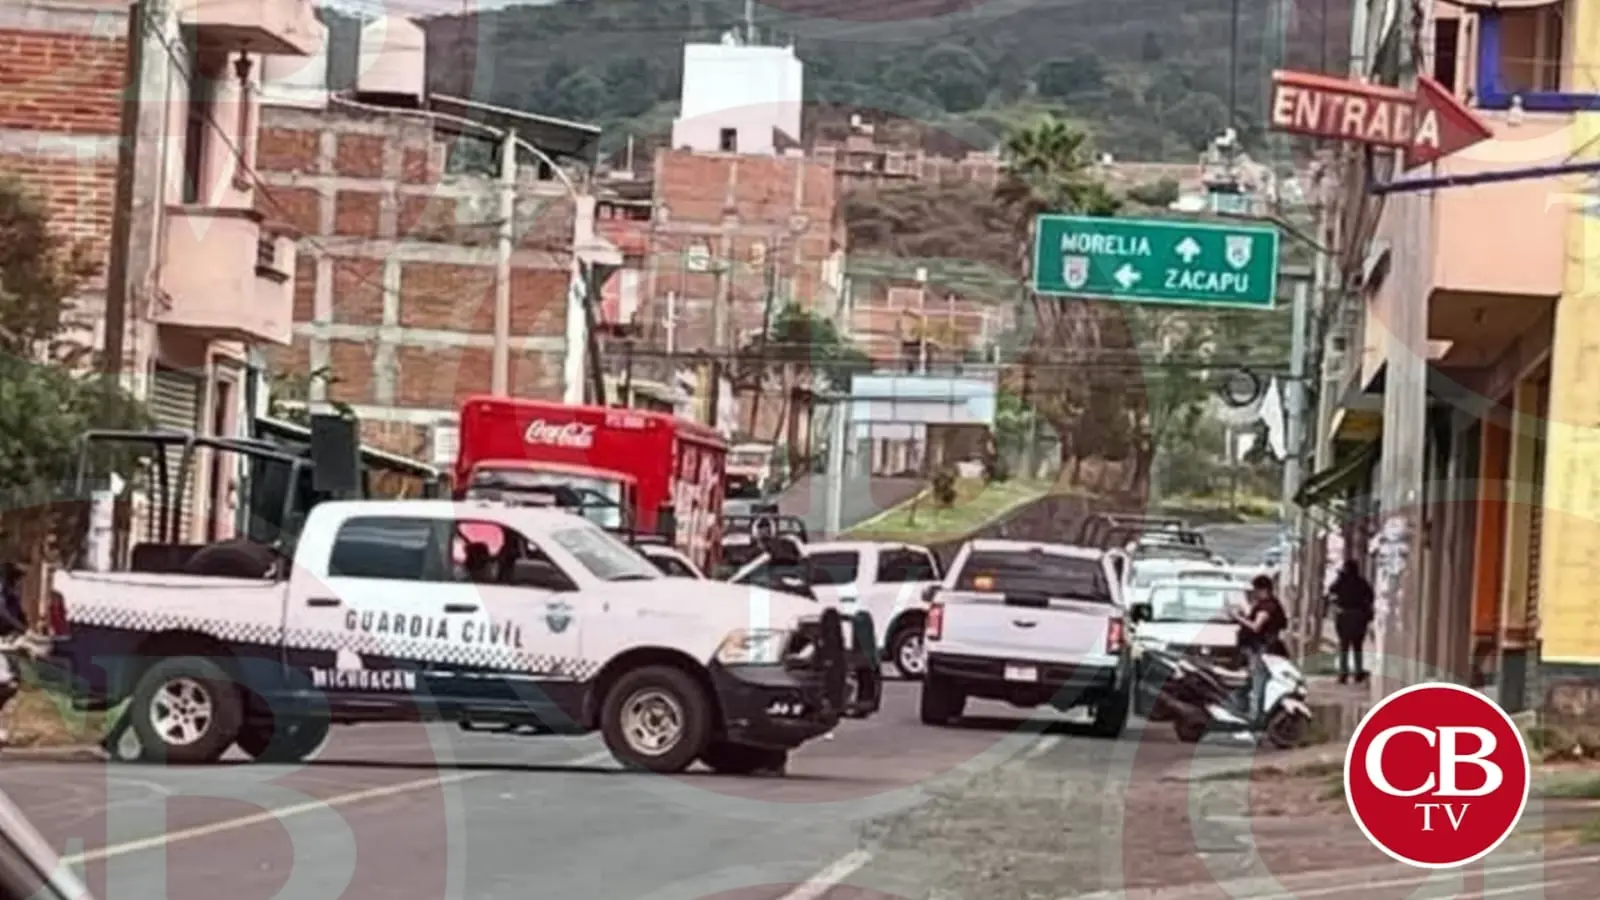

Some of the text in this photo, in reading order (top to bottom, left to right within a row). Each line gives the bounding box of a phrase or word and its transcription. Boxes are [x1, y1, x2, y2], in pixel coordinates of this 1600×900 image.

[1272, 84, 1440, 149] ENTRADA
[1060, 232, 1152, 256] MORELIA
[1164, 268, 1250, 292] ZACAPU
[345, 608, 449, 640] GUARDIA
